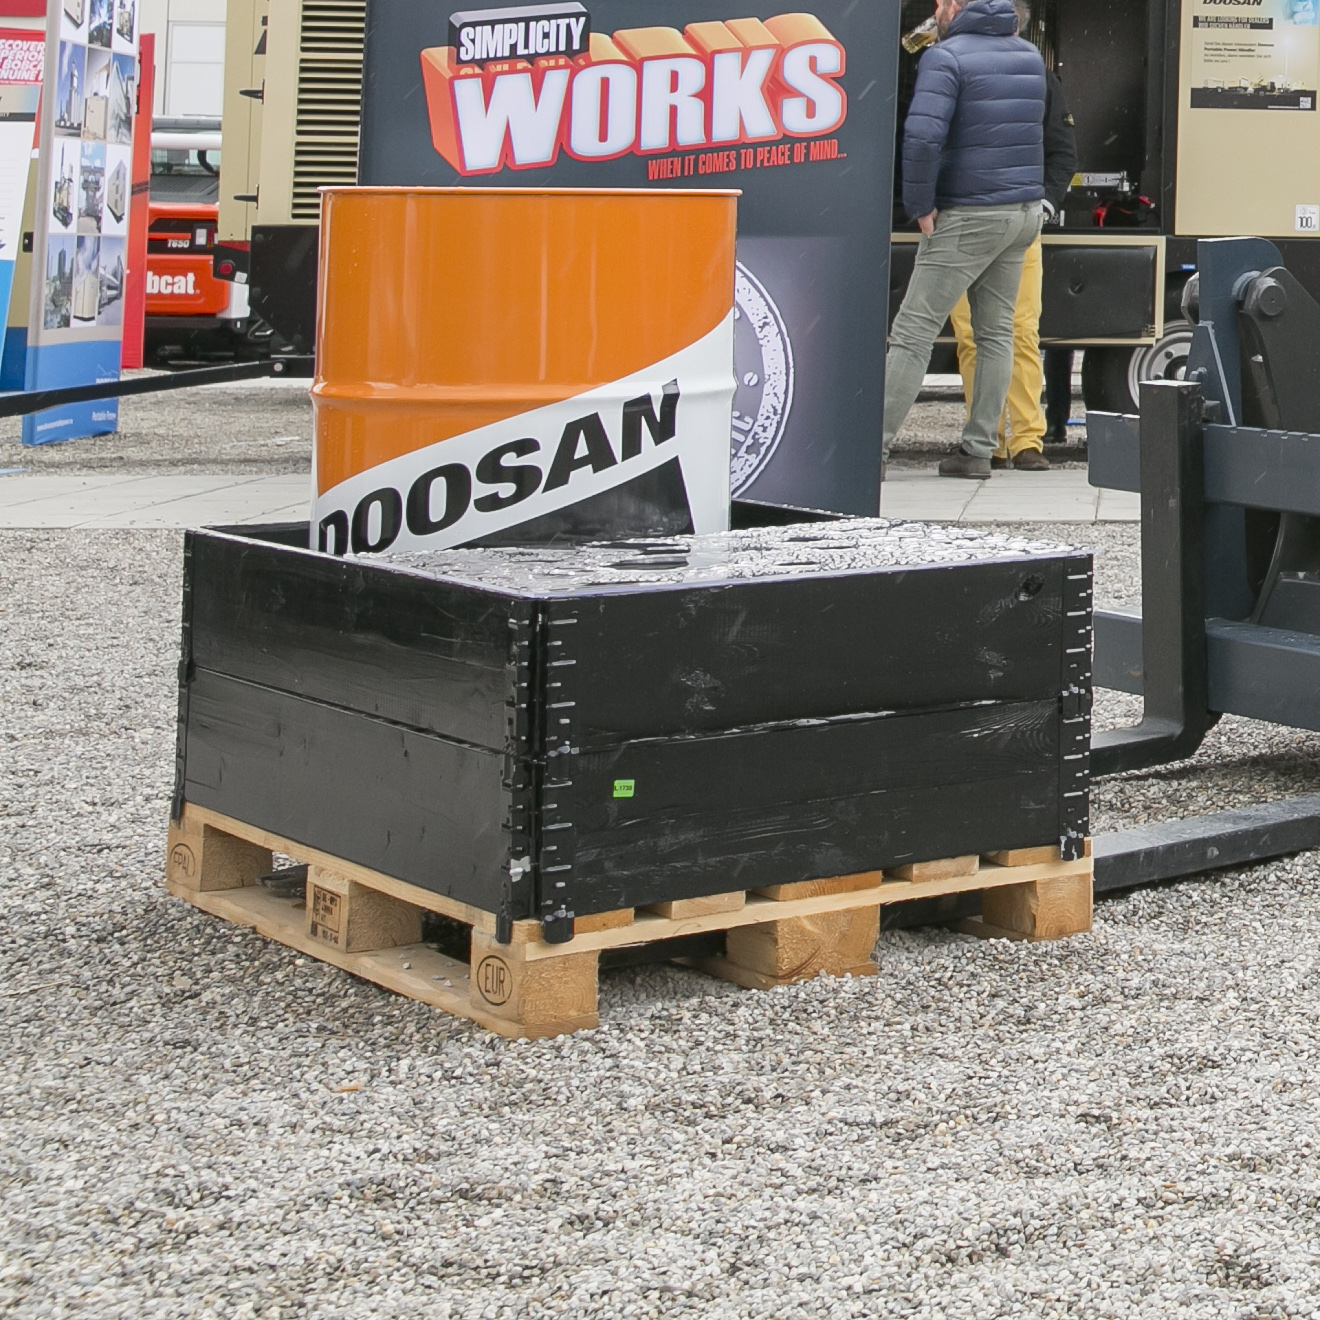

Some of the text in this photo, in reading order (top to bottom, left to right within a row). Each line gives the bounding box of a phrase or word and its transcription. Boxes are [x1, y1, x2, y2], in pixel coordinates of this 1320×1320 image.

[460, 16, 586, 61] SIMPLICITY
[453, 43, 842, 171] WORKS
[648, 139, 847, 180] WHEN IT COMES TO PEACE OF MIND...
[1298, 216, 1313, 229] 100
[146, 271, 195, 294] bcat
[319, 378, 678, 555] DOOSAN
[485, 963, 505, 997] EUR
